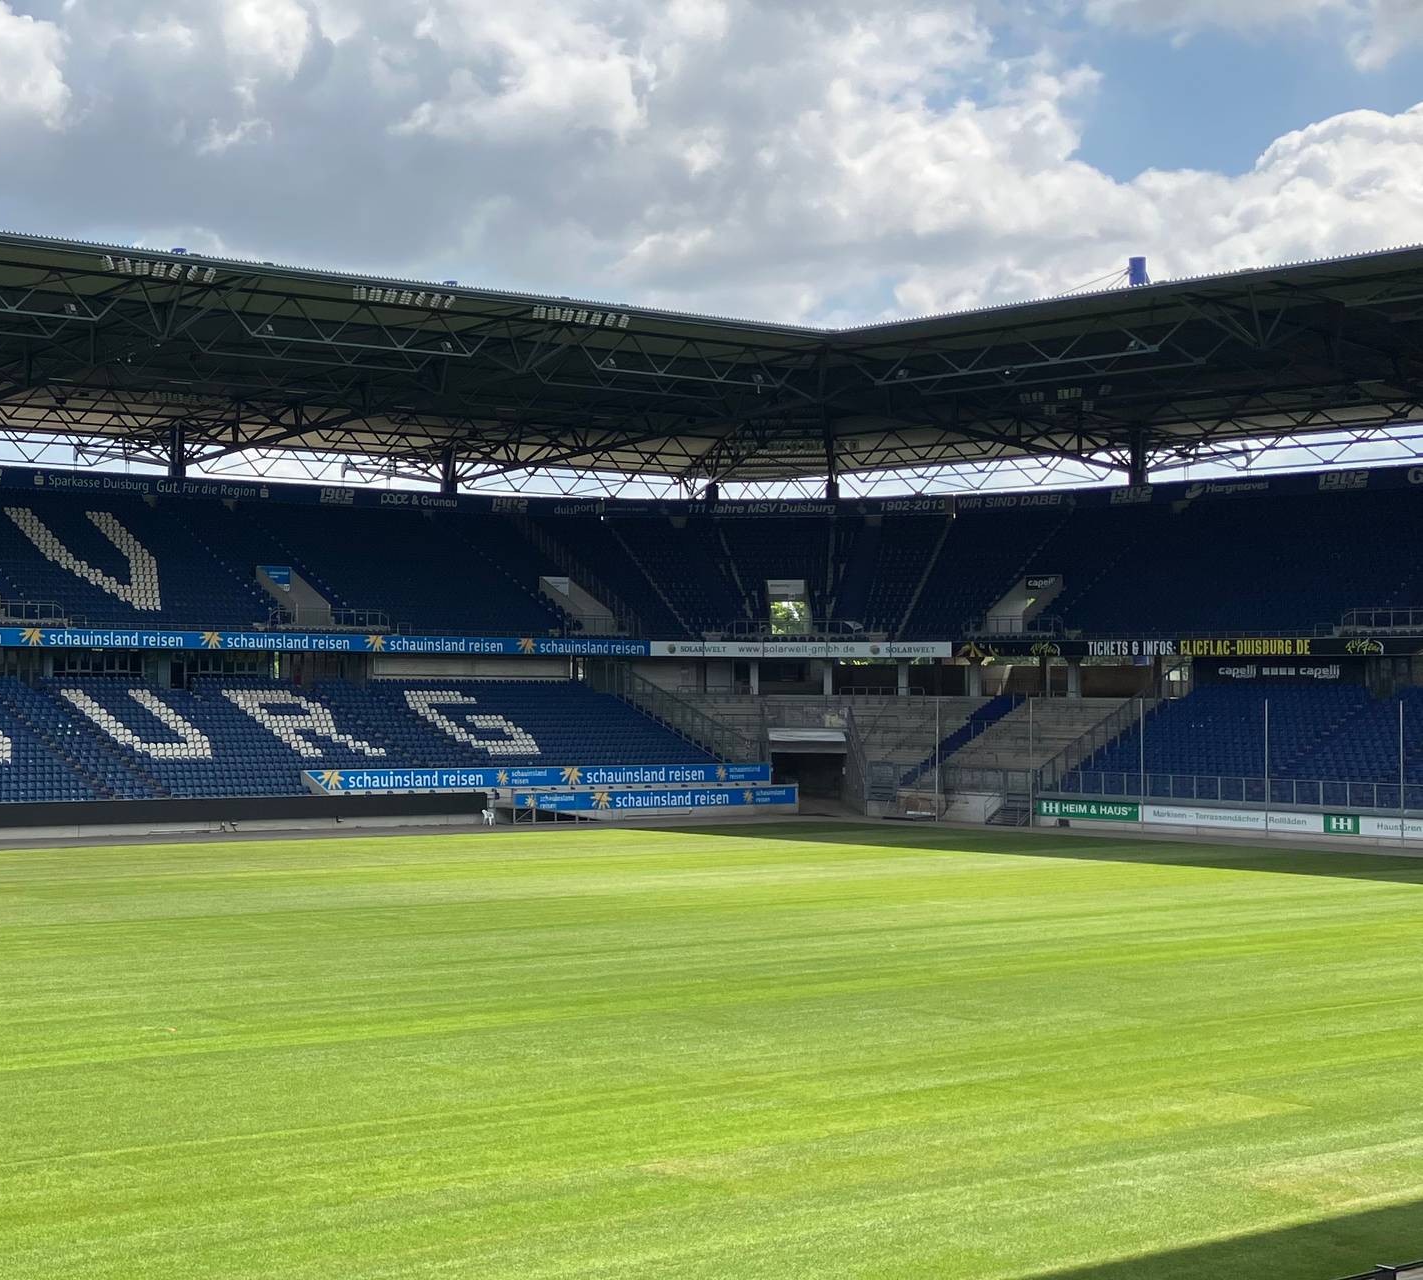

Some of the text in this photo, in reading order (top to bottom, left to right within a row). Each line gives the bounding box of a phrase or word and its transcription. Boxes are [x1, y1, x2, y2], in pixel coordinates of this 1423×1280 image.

[1318, 470, 1370, 486] 1902
[48, 474, 101, 490] Sparkasse
[104, 477, 149, 494] Duisburg
[182, 482, 199, 495] Für
[201, 485, 217, 496] die
[220, 485, 256, 499] Region
[411, 494, 420, 505] &
[421, 494, 458, 508] Grunau
[688, 502, 836, 515] 111 Jahre MSV Duisburg
[880, 494, 1063, 512] 1902-2013 WIR SIND DABEI
[49, 629, 184, 647] schauinsland reisen
[227, 632, 350, 650] schauinsland reisen
[390, 638, 503, 653] schauinsland reisen
[540, 640, 645, 655] schauinsland reisen
[680, 645, 727, 653] SOLARWELT
[885, 646, 936, 654] SOLARWELT
[1087, 641, 1128, 656] TICKETS
[1131, 641, 1139, 656] &
[1218, 664, 1257, 679] capelli
[1299, 664, 1341, 679] capelli
[348, 770, 484, 788] schauinsland reisen
[511, 769, 548, 777] schauinsland
[586, 766, 705, 784] schauinsland reisen
[615, 791, 729, 807] schauinsland reisen
[1062, 803, 1088, 814] HEIM
[1090, 804, 1097, 814] &
